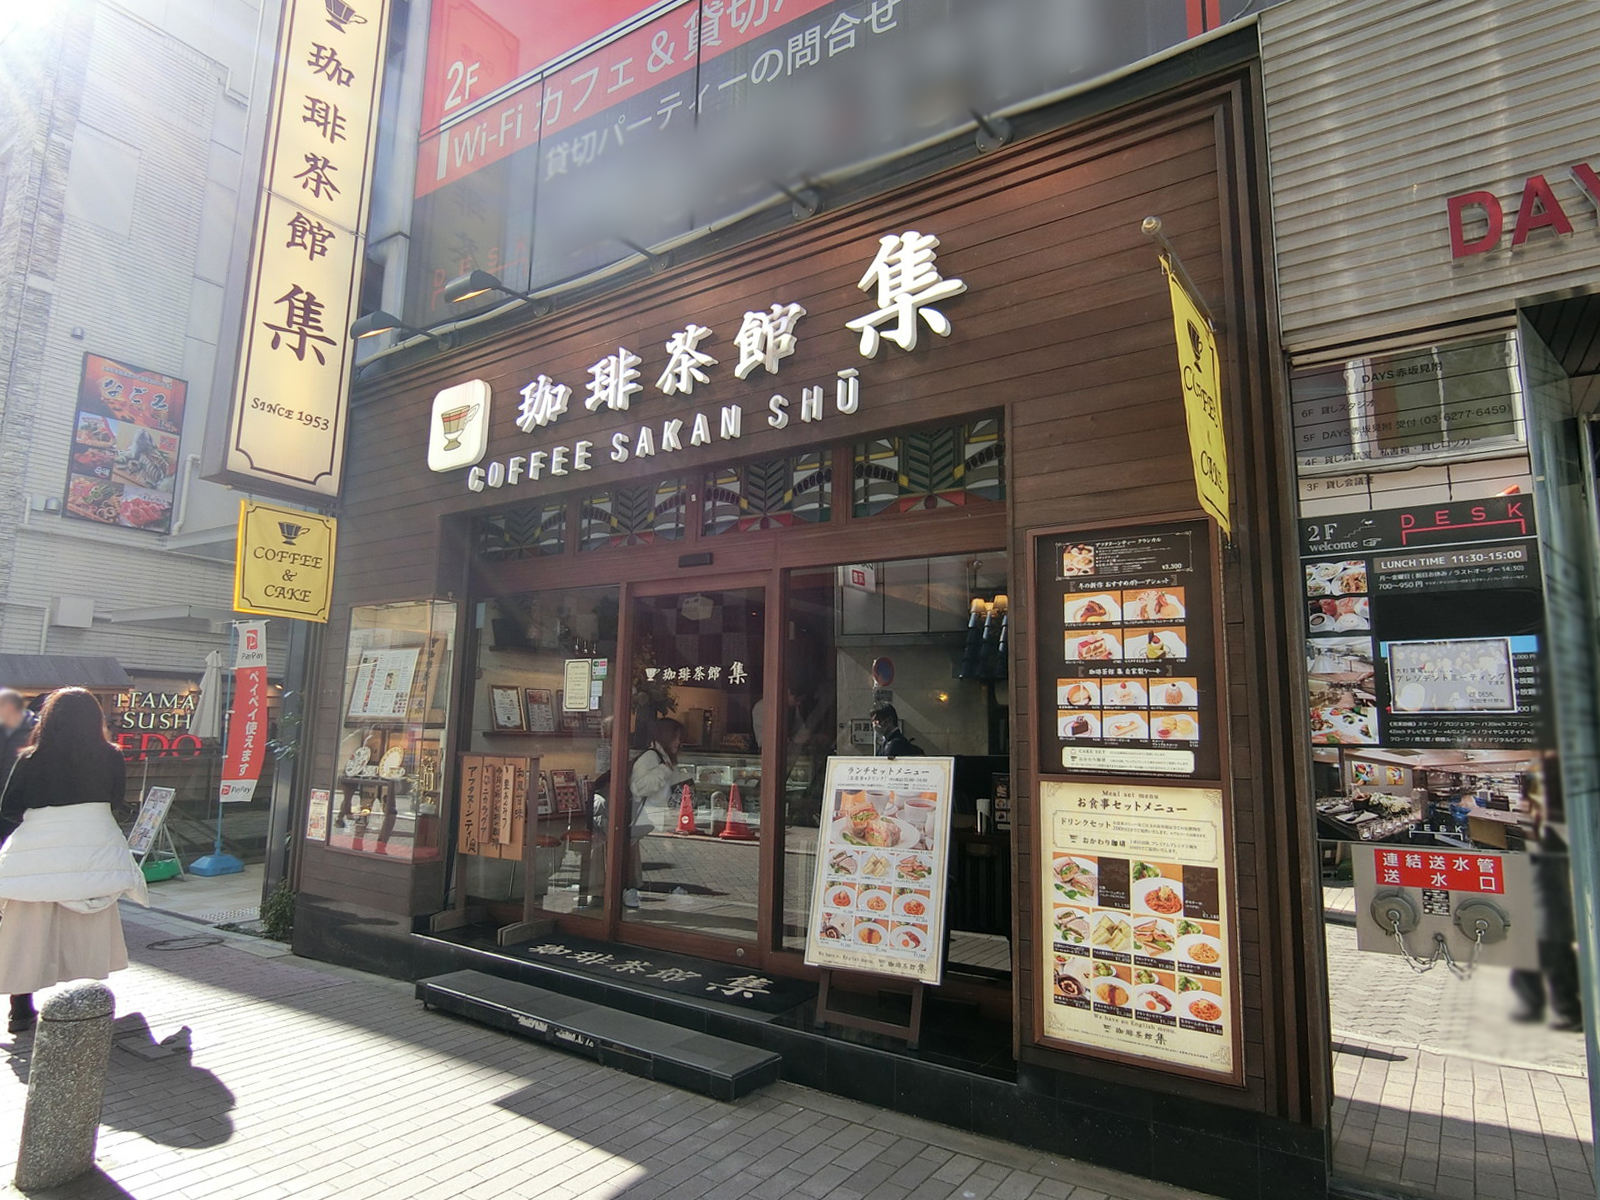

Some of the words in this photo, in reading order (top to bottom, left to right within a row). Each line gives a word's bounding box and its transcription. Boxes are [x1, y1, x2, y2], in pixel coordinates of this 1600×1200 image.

[446, 61, 480, 110] 2F
[453, 103, 523, 168] Wi-Fi
[286, 42, 355, 261] 珈琲茶館
[262, 283, 338, 366] 集
[515, 303, 807, 433] 珈琲茶館
[845, 230, 968, 358] 集
[251, 398, 294, 419] SINCE
[297, 411, 329, 431] 1953
[1301, 409, 1315, 418] 6F
[467, 440, 593, 493] COFFEE
[611, 405, 742, 463] SAKAN
[1303, 433, 1315, 443] 5F
[1304, 458, 1317, 466] 4F
[1306, 482, 1319, 491] 3F
[1401, 502, 1523, 529] DESK
[1309, 540, 1358, 552] welcome
[253, 546, 323, 569] COFFEE
[1381, 558, 1417, 570] LUNCH
[1419, 556, 1446, 566] TIME
[1451, 550, 1522, 564] 11:30-15:00
[282, 569, 298, 582] &
[264, 584, 312, 603] CAKE
[662, 666, 721, 681] 珈琲茶館
[728, 661, 748, 685] 集
[117, 692, 194, 710] ITAMA
[122, 711, 191, 730] SUSH
[238, 671, 260, 777] ペイペイ使えます
[116, 733, 203, 762] EDO
[1077, 797, 1188, 814] お食事セットメニュー
[1060, 817, 1111, 829] ドリンクセット
[1383, 852, 1494, 874] 連結送水管
[1384, 869, 1495, 891] 送水口
[529, 943, 702, 983] 珈琲茶館
[705, 975, 774, 998] 集
